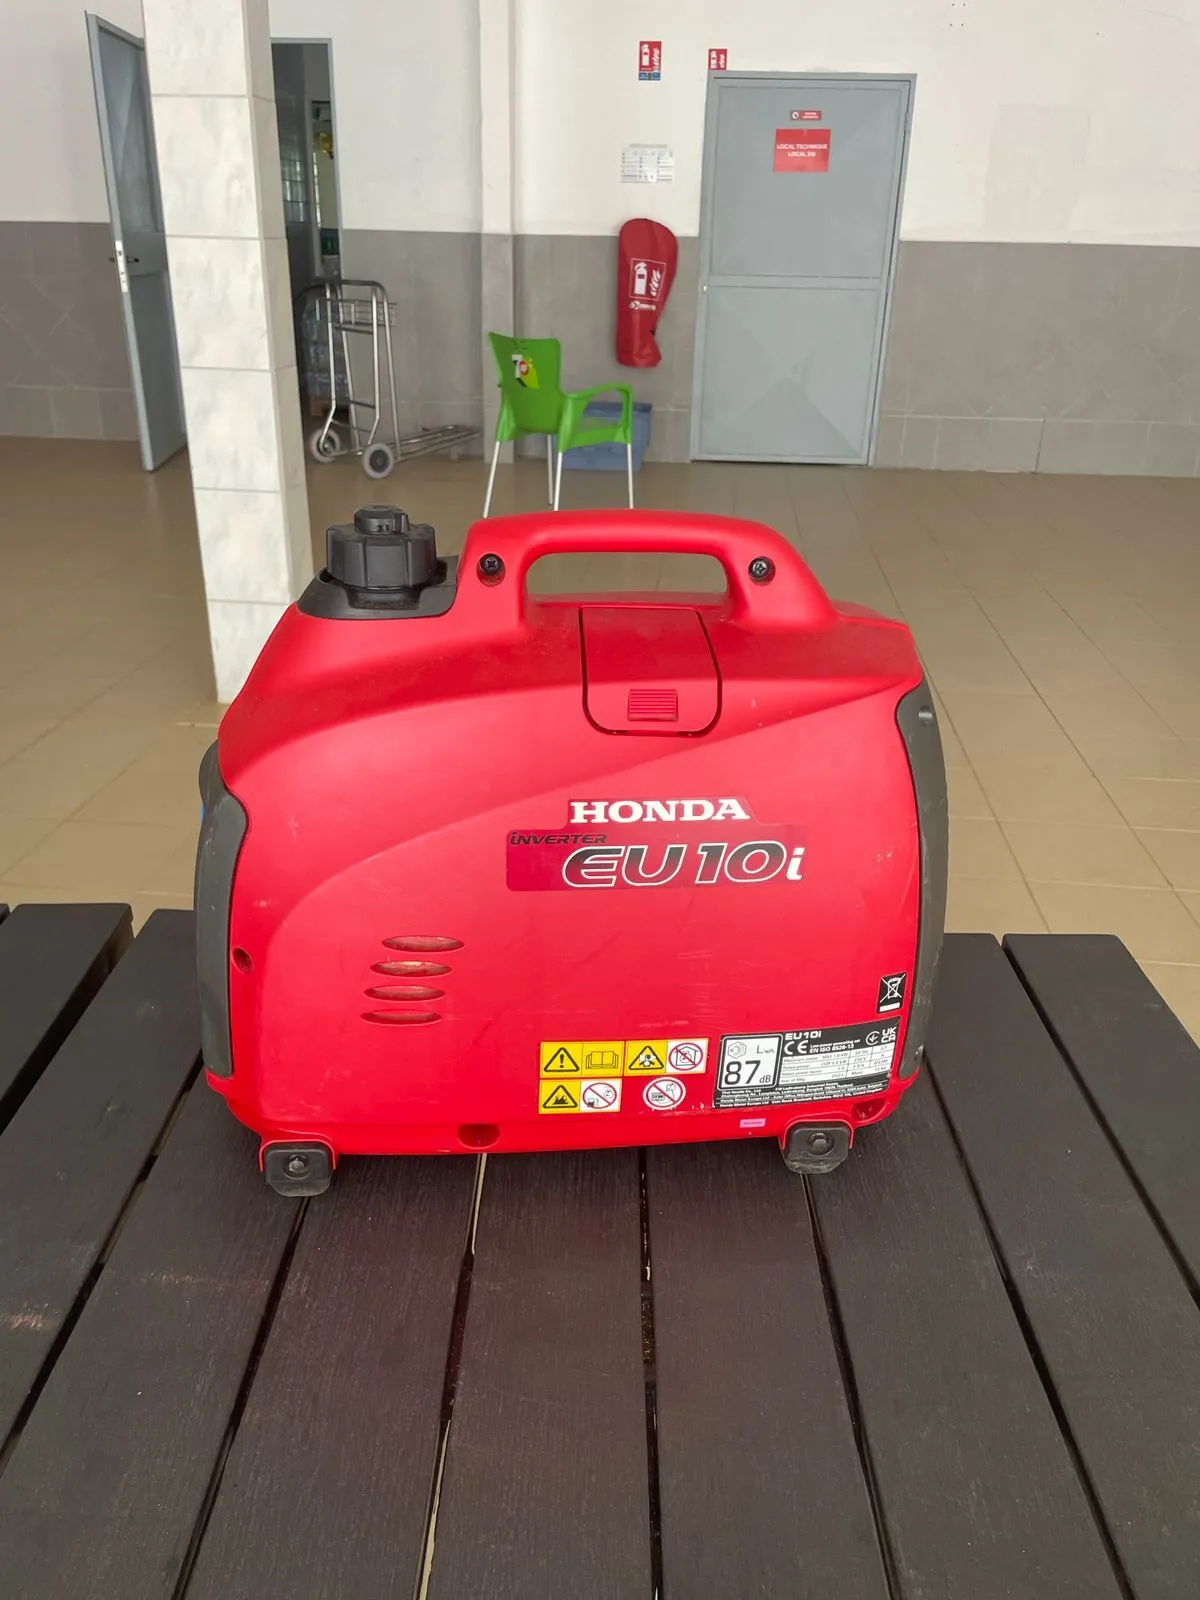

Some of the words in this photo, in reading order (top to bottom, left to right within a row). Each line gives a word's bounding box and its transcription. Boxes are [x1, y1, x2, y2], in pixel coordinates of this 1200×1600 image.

[569, 798, 751, 824] HONDA
[882, 1027, 897, 1036] UK
[881, 1034, 896, 1043] CA
[724, 1059, 761, 1085] 87
[759, 1075, 771, 1083] dB
